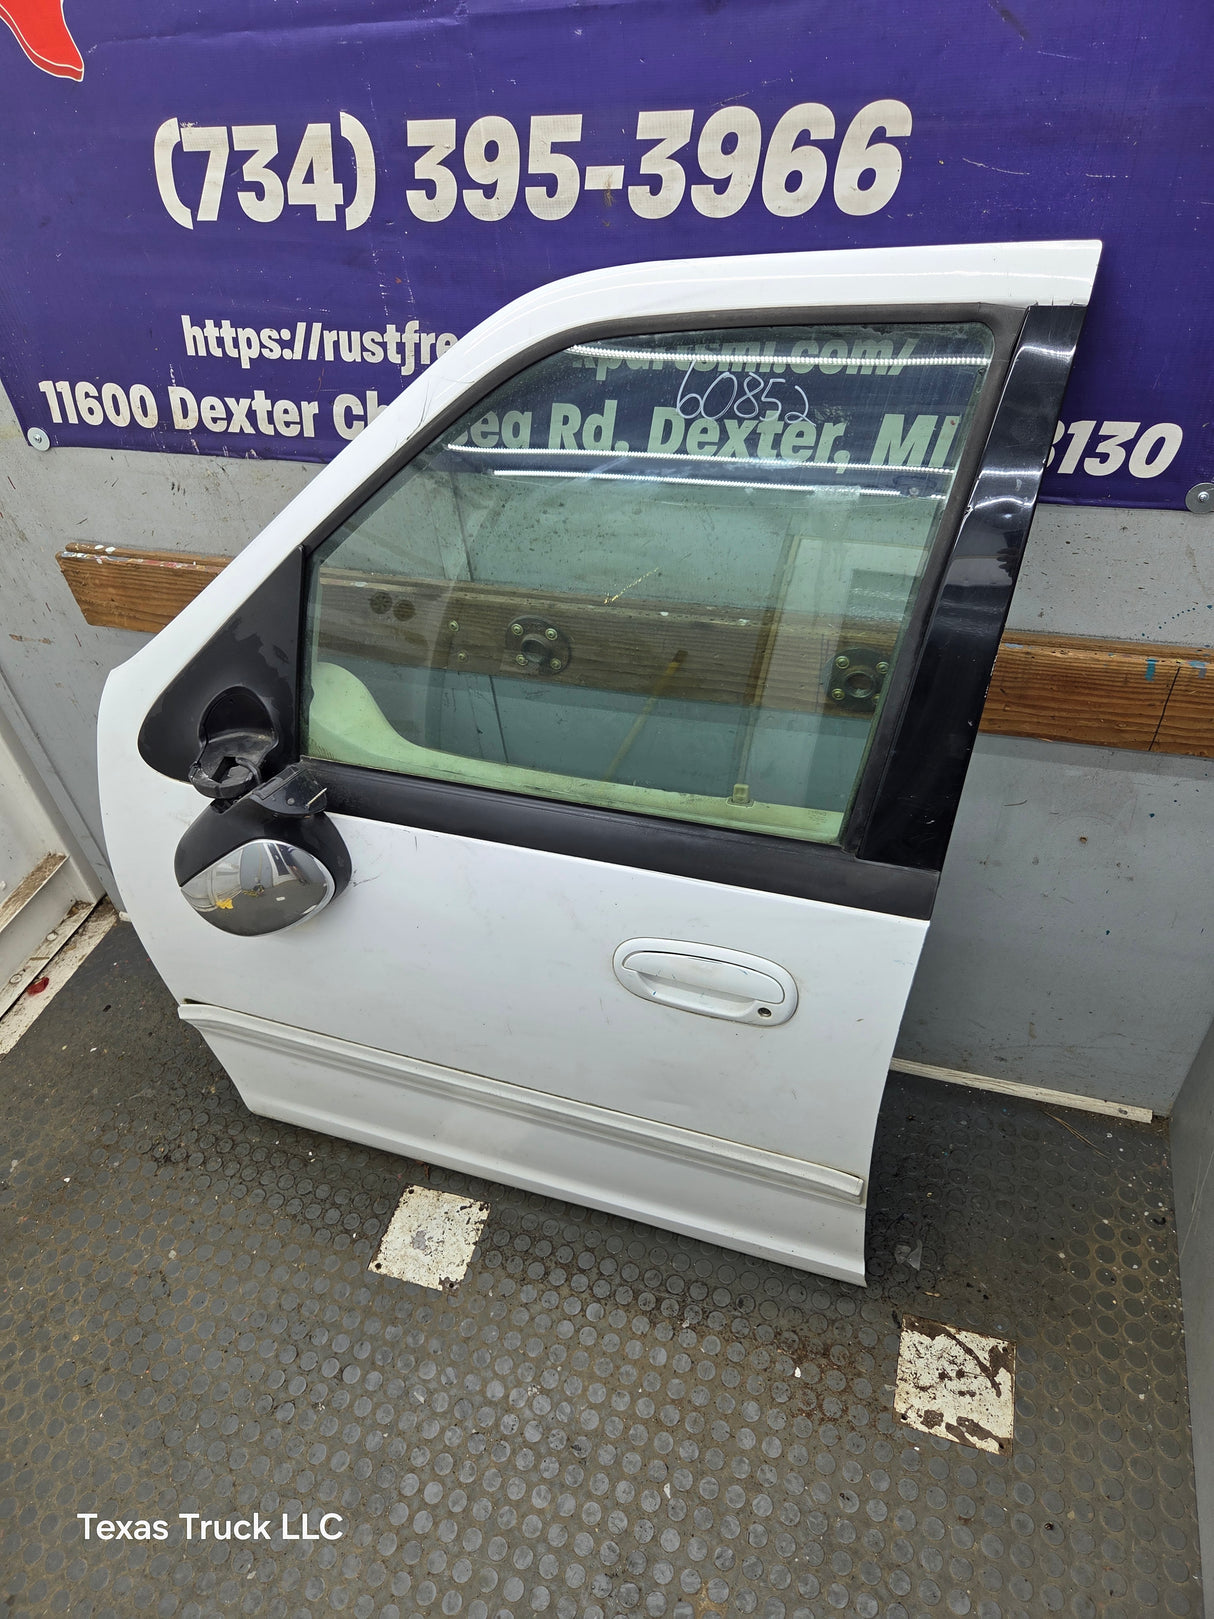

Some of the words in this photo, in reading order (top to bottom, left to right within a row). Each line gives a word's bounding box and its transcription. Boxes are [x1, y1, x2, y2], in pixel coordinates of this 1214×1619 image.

[153, 111, 376, 230] (734)
[406, 99, 913, 222] 395-3966
[38, 380, 159, 429] 11600
[168, 385, 320, 438] Dexter
[548, 400, 630, 452] Rd.
[648, 407, 851, 474] Dexter,
[869, 414, 961, 468] MI
[676, 358, 817, 427] 60852
